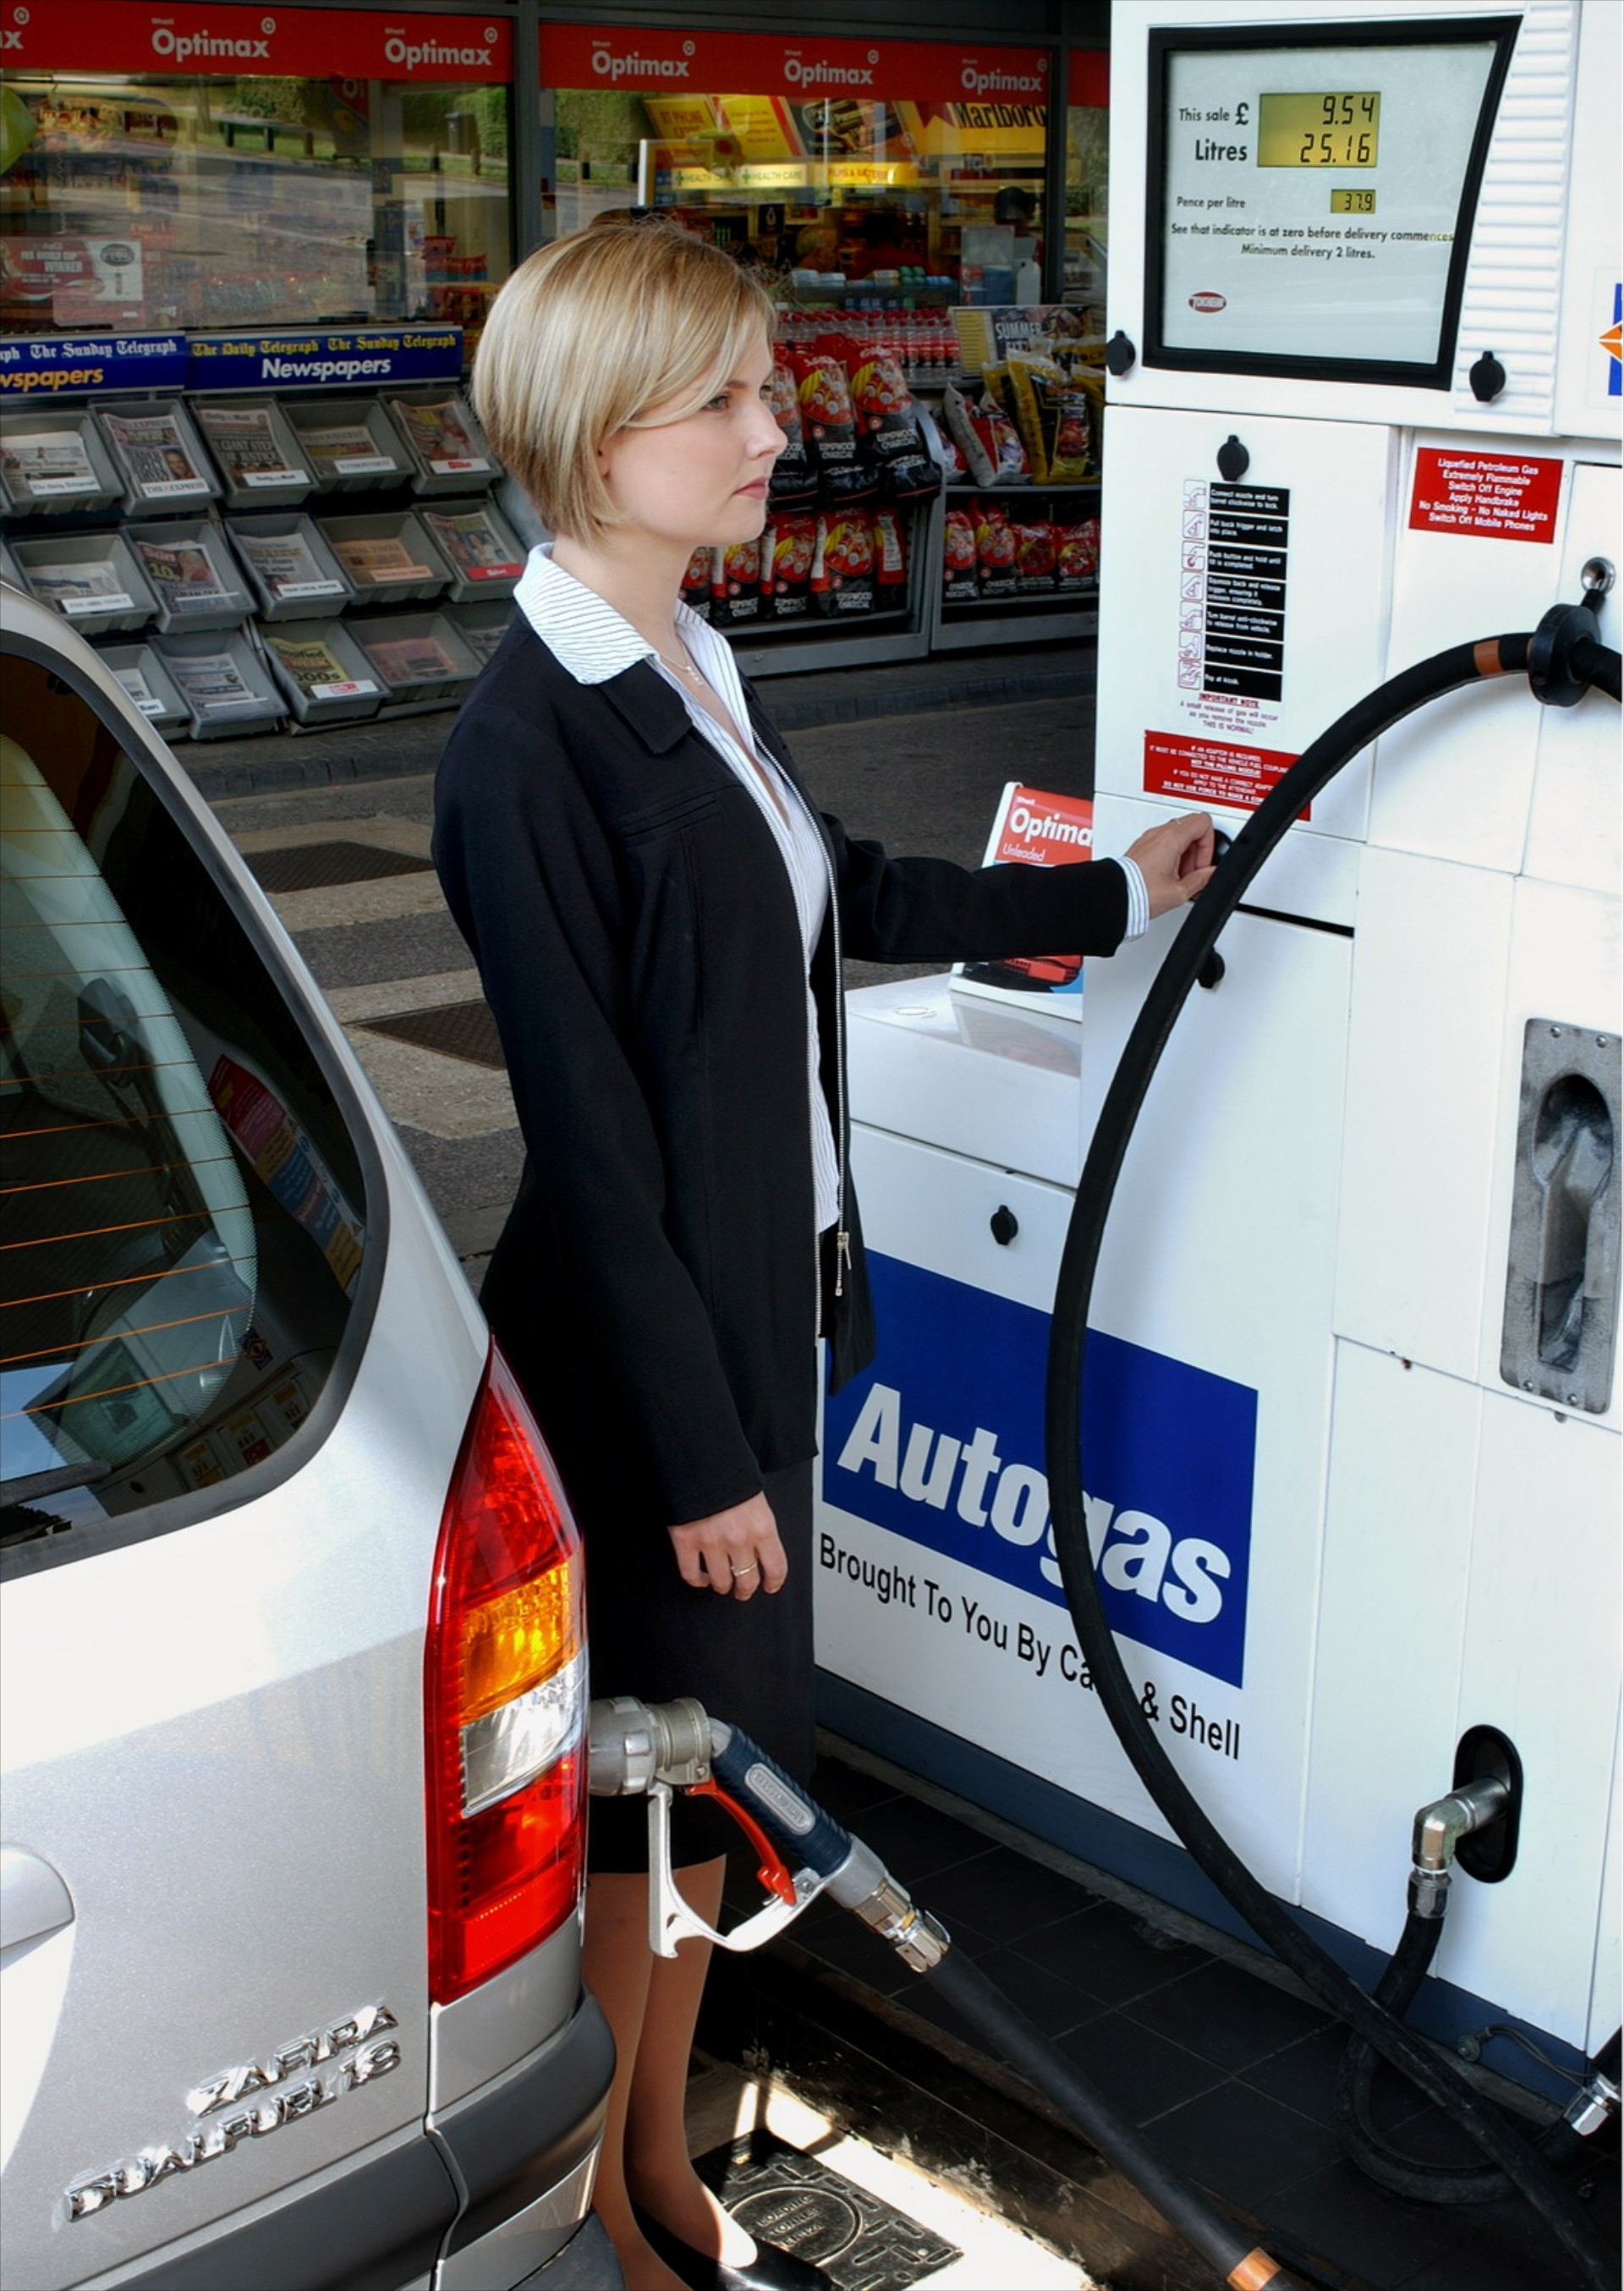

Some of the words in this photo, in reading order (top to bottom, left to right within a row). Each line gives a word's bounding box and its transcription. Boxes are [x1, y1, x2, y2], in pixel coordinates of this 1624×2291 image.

[152, 28, 270, 63] Optimax
[385, 38, 492, 70] Optimax
[592, 50, 689, 81] Optimax
[784, 59, 874, 89] Optimax
[962, 68, 1042, 96] Optimax
[952, 102, 1047, 129] Marlboro
[1179, 107, 1202, 122] This
[1205, 107, 1230, 122] sale
[1235, 102, 1249, 126] £
[1323, 96, 1375, 125] 9.54
[1195, 139, 1248, 162] Litres
[1300, 133, 1371, 163] 25.16
[1177, 196, 1204, 207] Pence
[1207, 200, 1224, 210] per
[1226, 196, 1246, 208] litre
[1344, 193, 1373, 212] 37.9
[1171, 223, 1188, 234] See
[1191, 223, 1210, 235] that
[1212, 224, 1255, 236] indicator
[1259, 225, 1266, 237] is
[1270, 227, 1280, 237] at
[1282, 228, 1305, 238] zero
[1308, 226, 1341, 239] before
[1345, 227, 1387, 243] delivery
[1391, 231, 1454, 241] commences
[1242, 244, 1288, 255] Minimum
[1291, 244, 1333, 260] delivery
[1336, 246, 1343, 258] 2
[1346, 246, 1375, 259] litres.
[996, 321, 1043, 339] SUMMER
[30, 343, 56, 359] The
[62, 343, 112, 359] Sunday
[116, 339, 177, 355] Telegraph
[192, 343, 217, 355] The
[222, 343, 255, 357] Daily
[261, 339, 319, 354] Telegraph
[327, 338, 351, 350] The
[357, 336, 399, 351] Sunday
[403, 334, 456, 349] Telegraph
[261, 358, 392, 382] Newspapers
[1443, 470, 1484, 482] Extremely
[1486, 473, 1531, 486] Flammable
[1478, 460, 1519, 473] Petroleum
[1522, 464, 1539, 475] Gas
[1448, 481, 1476, 492] Switch
[1479, 483, 1492, 492] Off
[1495, 485, 1522, 497] Engine
[1419, 500, 1430, 510] No
[1433, 501, 1468, 514] Smoking
[1478, 506, 1490, 516] No
[1493, 508, 1520, 518] Naked
[1522, 509, 1548, 521] Lights
[1449, 492, 1472, 504] Apply
[1474, 495, 1520, 508] Handbrake
[1429, 512, 1456, 524] Switch
[1459, 514, 1472, 525] Off
[1474, 517, 1501, 528] Mobile
[1504, 519, 1535, 531] Phones
[1199, 693, 1238, 705] IMPORTANT
[1002, 842, 1046, 863] Unleaded
[820, 1530, 918, 1609] Brought
[924, 1578, 952, 1624] To
[961, 1595, 1008, 1651] You
[1018, 1621, 1052, 1678] By
[1140, 1682, 1160, 1722] &
[1170, 1694, 1241, 1761] Shell
